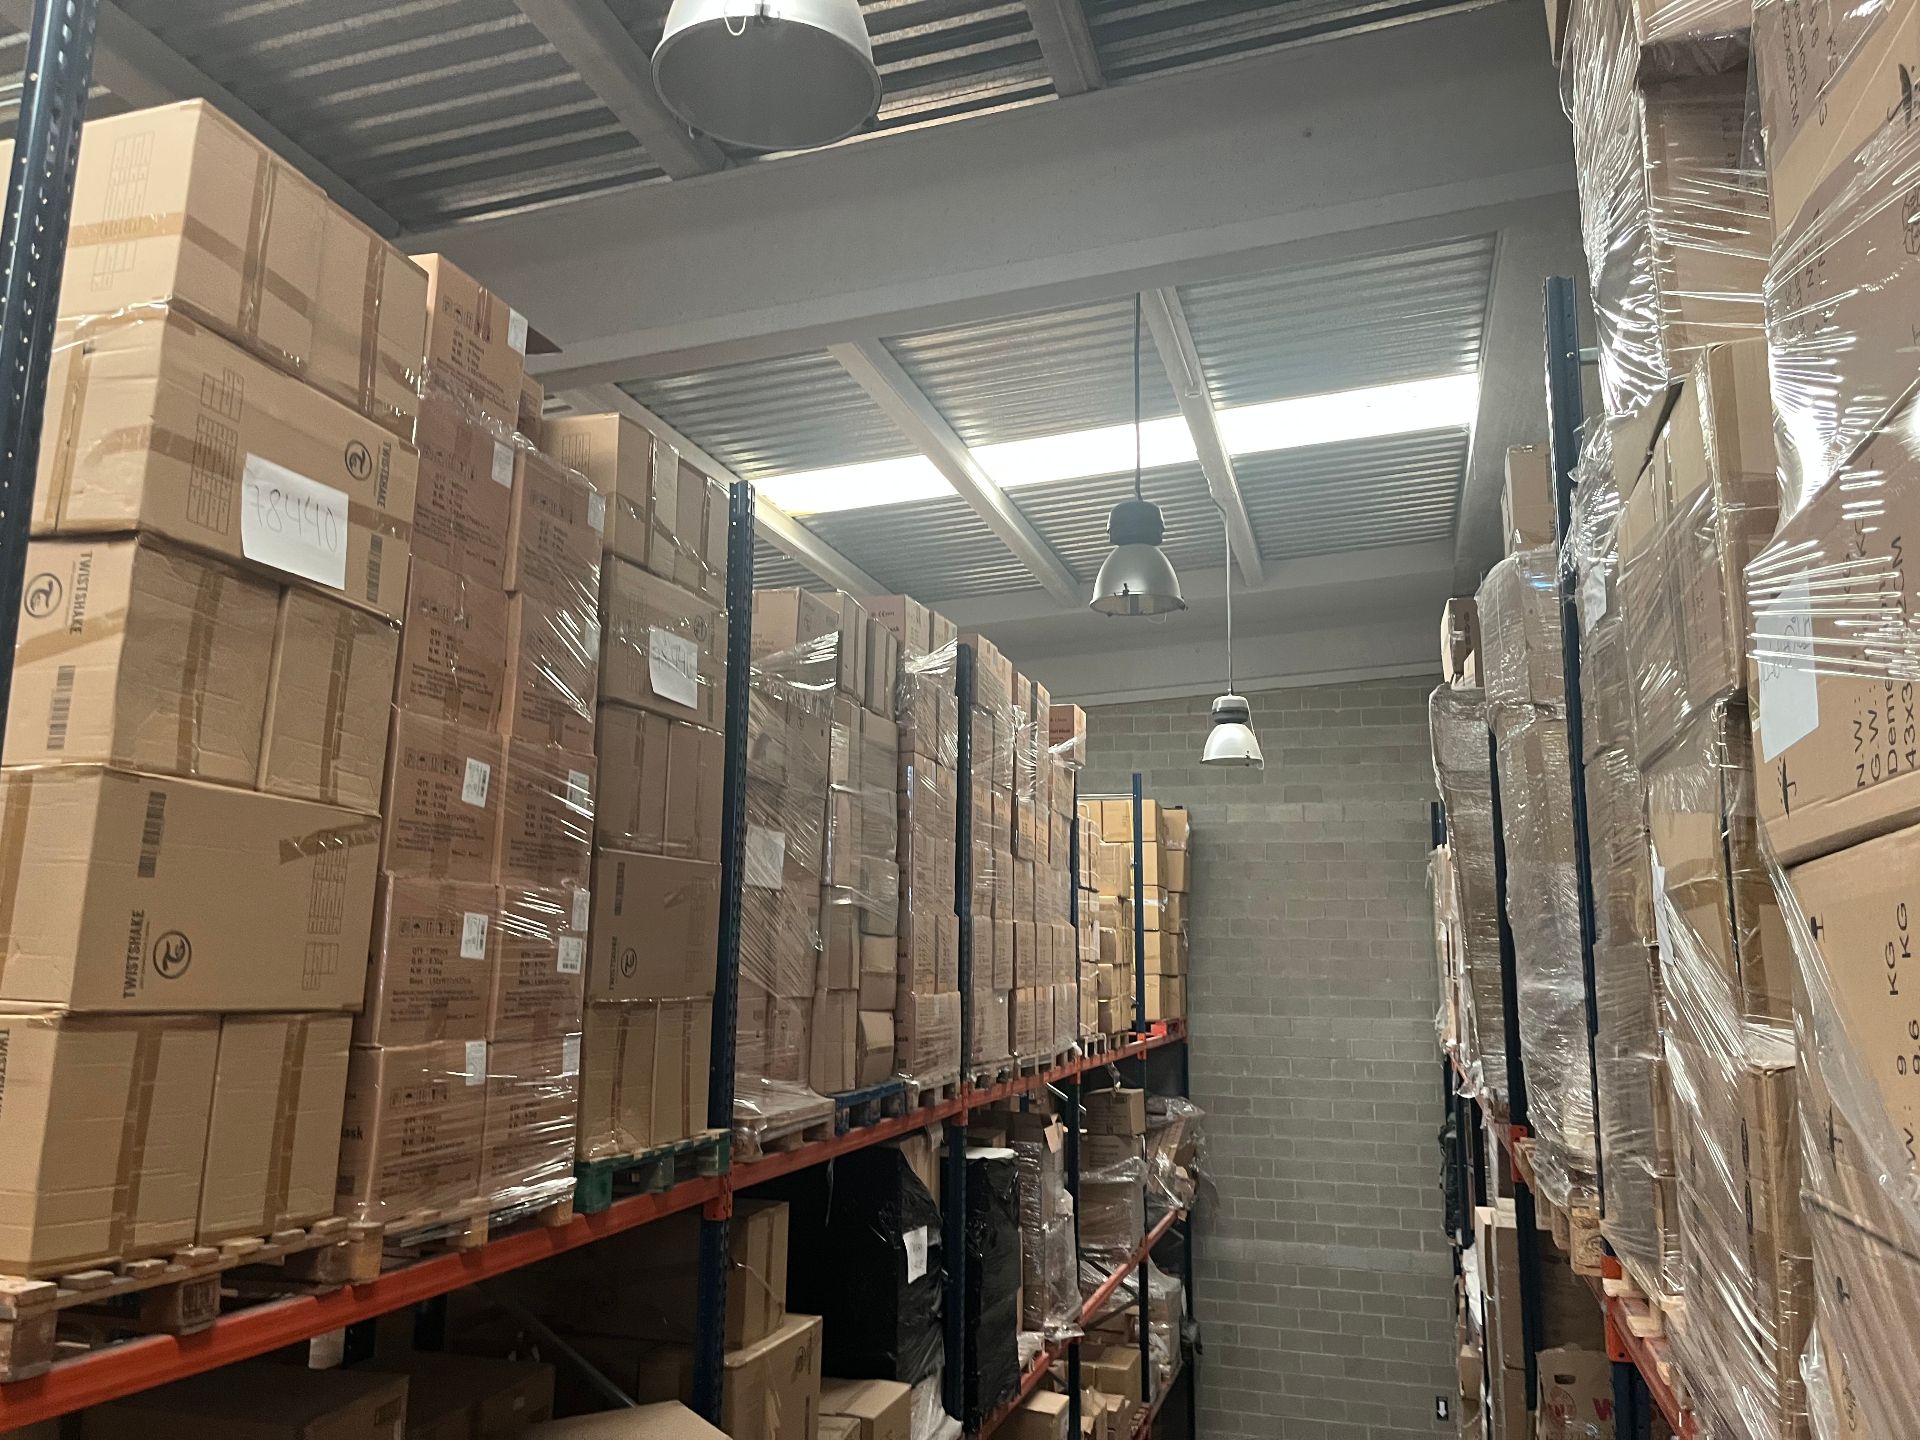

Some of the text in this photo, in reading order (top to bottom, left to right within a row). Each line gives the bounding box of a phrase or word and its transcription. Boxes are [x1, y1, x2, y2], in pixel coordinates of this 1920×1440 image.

[376, 440, 393, 510] TWISTSHAKE
[70, 550, 93, 636] TWISTSHAKE
[123, 909, 145, 999] TWISTSHAKE
[1896, 902, 1912, 959] KG
[1884, 941, 1899, 996] KG
[1896, 1053, 1907, 1075] 9
[341, 1126, 363, 1140] ask
